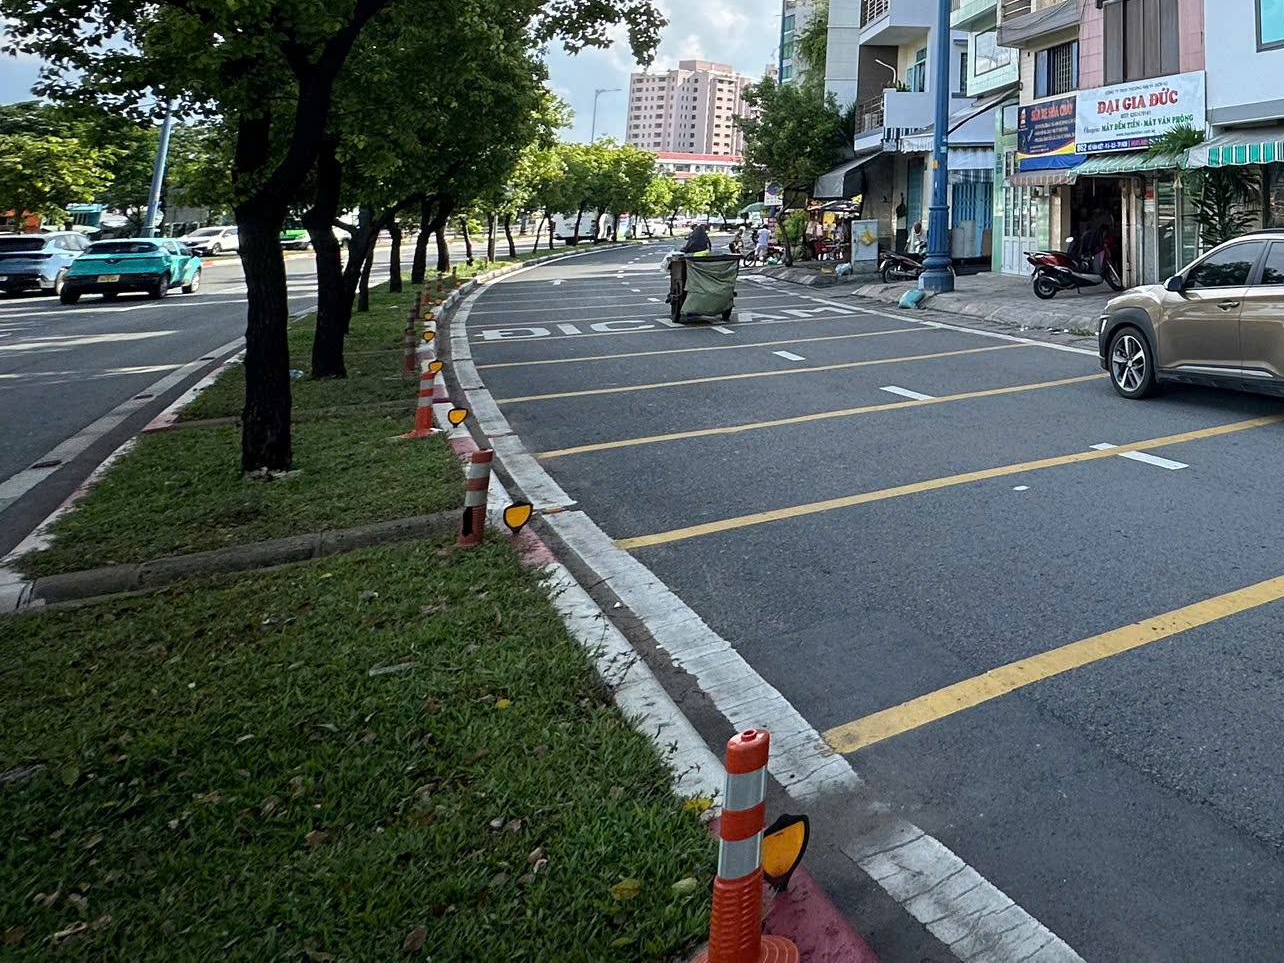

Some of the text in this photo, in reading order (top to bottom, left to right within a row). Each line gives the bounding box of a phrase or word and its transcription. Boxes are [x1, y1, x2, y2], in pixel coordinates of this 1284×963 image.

[1097, 98, 1120, 116] ĐẠI
[1122, 95, 1146, 110] GIA
[1149, 87, 1179, 107] ĐỨC
